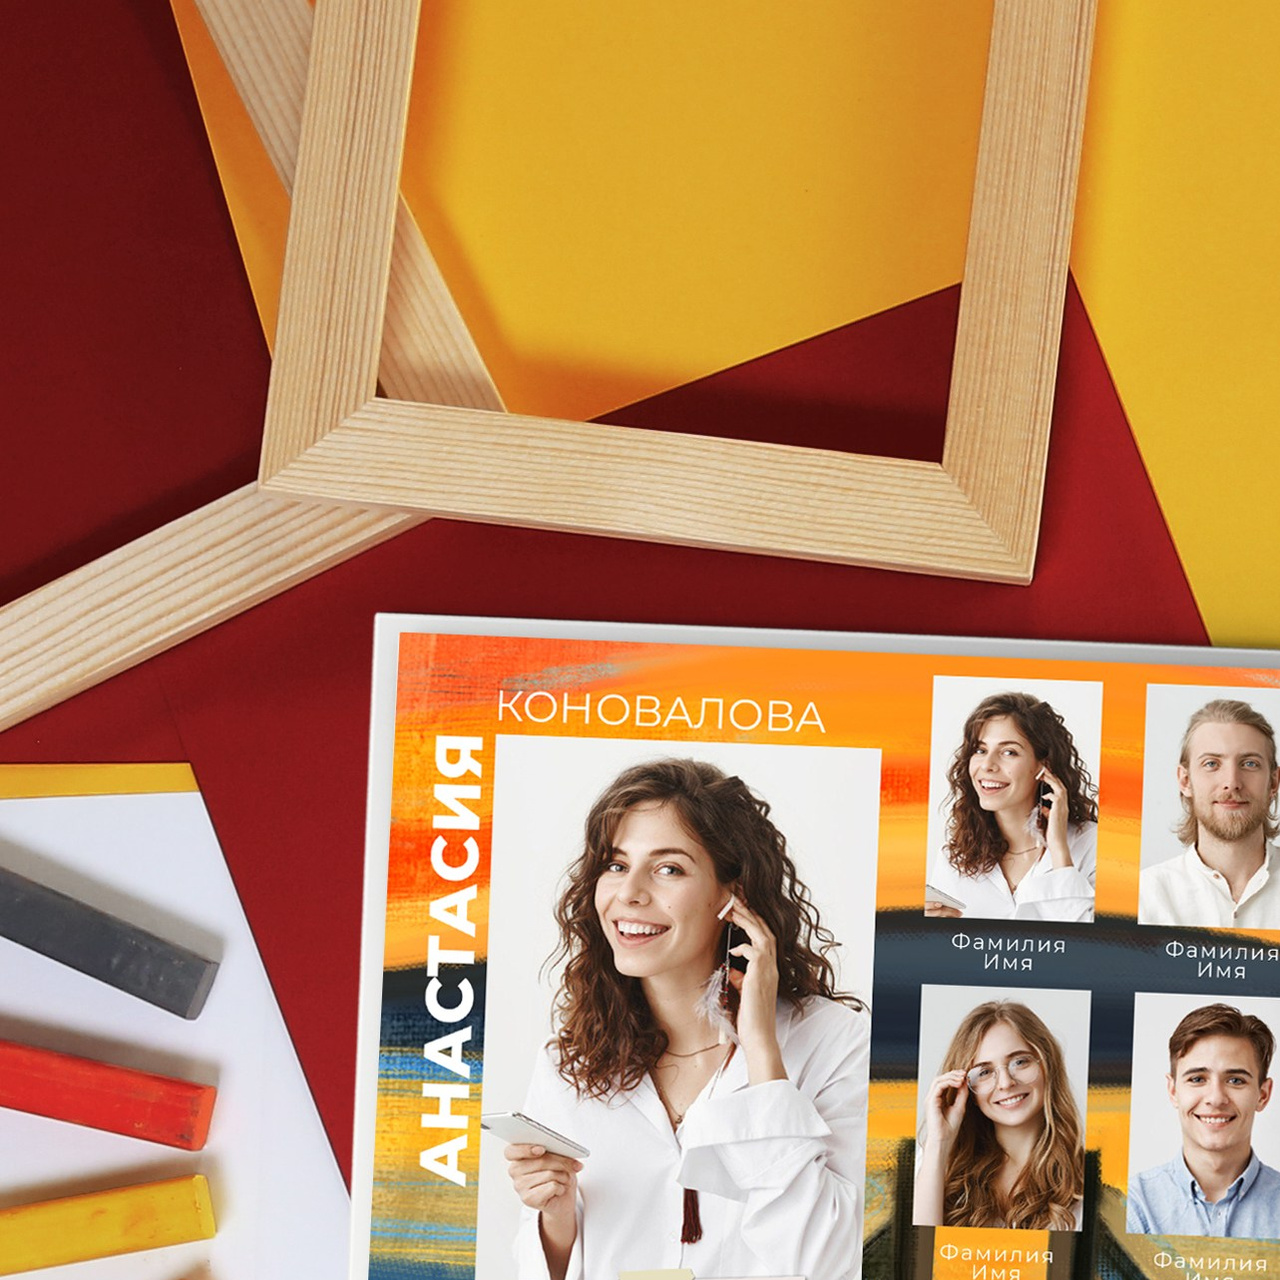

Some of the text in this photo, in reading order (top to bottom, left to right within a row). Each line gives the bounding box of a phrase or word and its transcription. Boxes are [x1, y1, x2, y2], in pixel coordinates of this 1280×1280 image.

[497, 690, 827, 733] КОНОВАЛОВА
[951, 932, 1066, 954] Фамилия
[1164, 940, 1279, 962] Фамилия
[419, 734, 484, 1188] АНАСТАСИЯ
[983, 953, 1034, 972] Имя
[1196, 961, 1247, 980] Имя
[939, 1243, 1054, 1265] Фамилия
[1153, 1251, 1268, 1273] Фамилия
